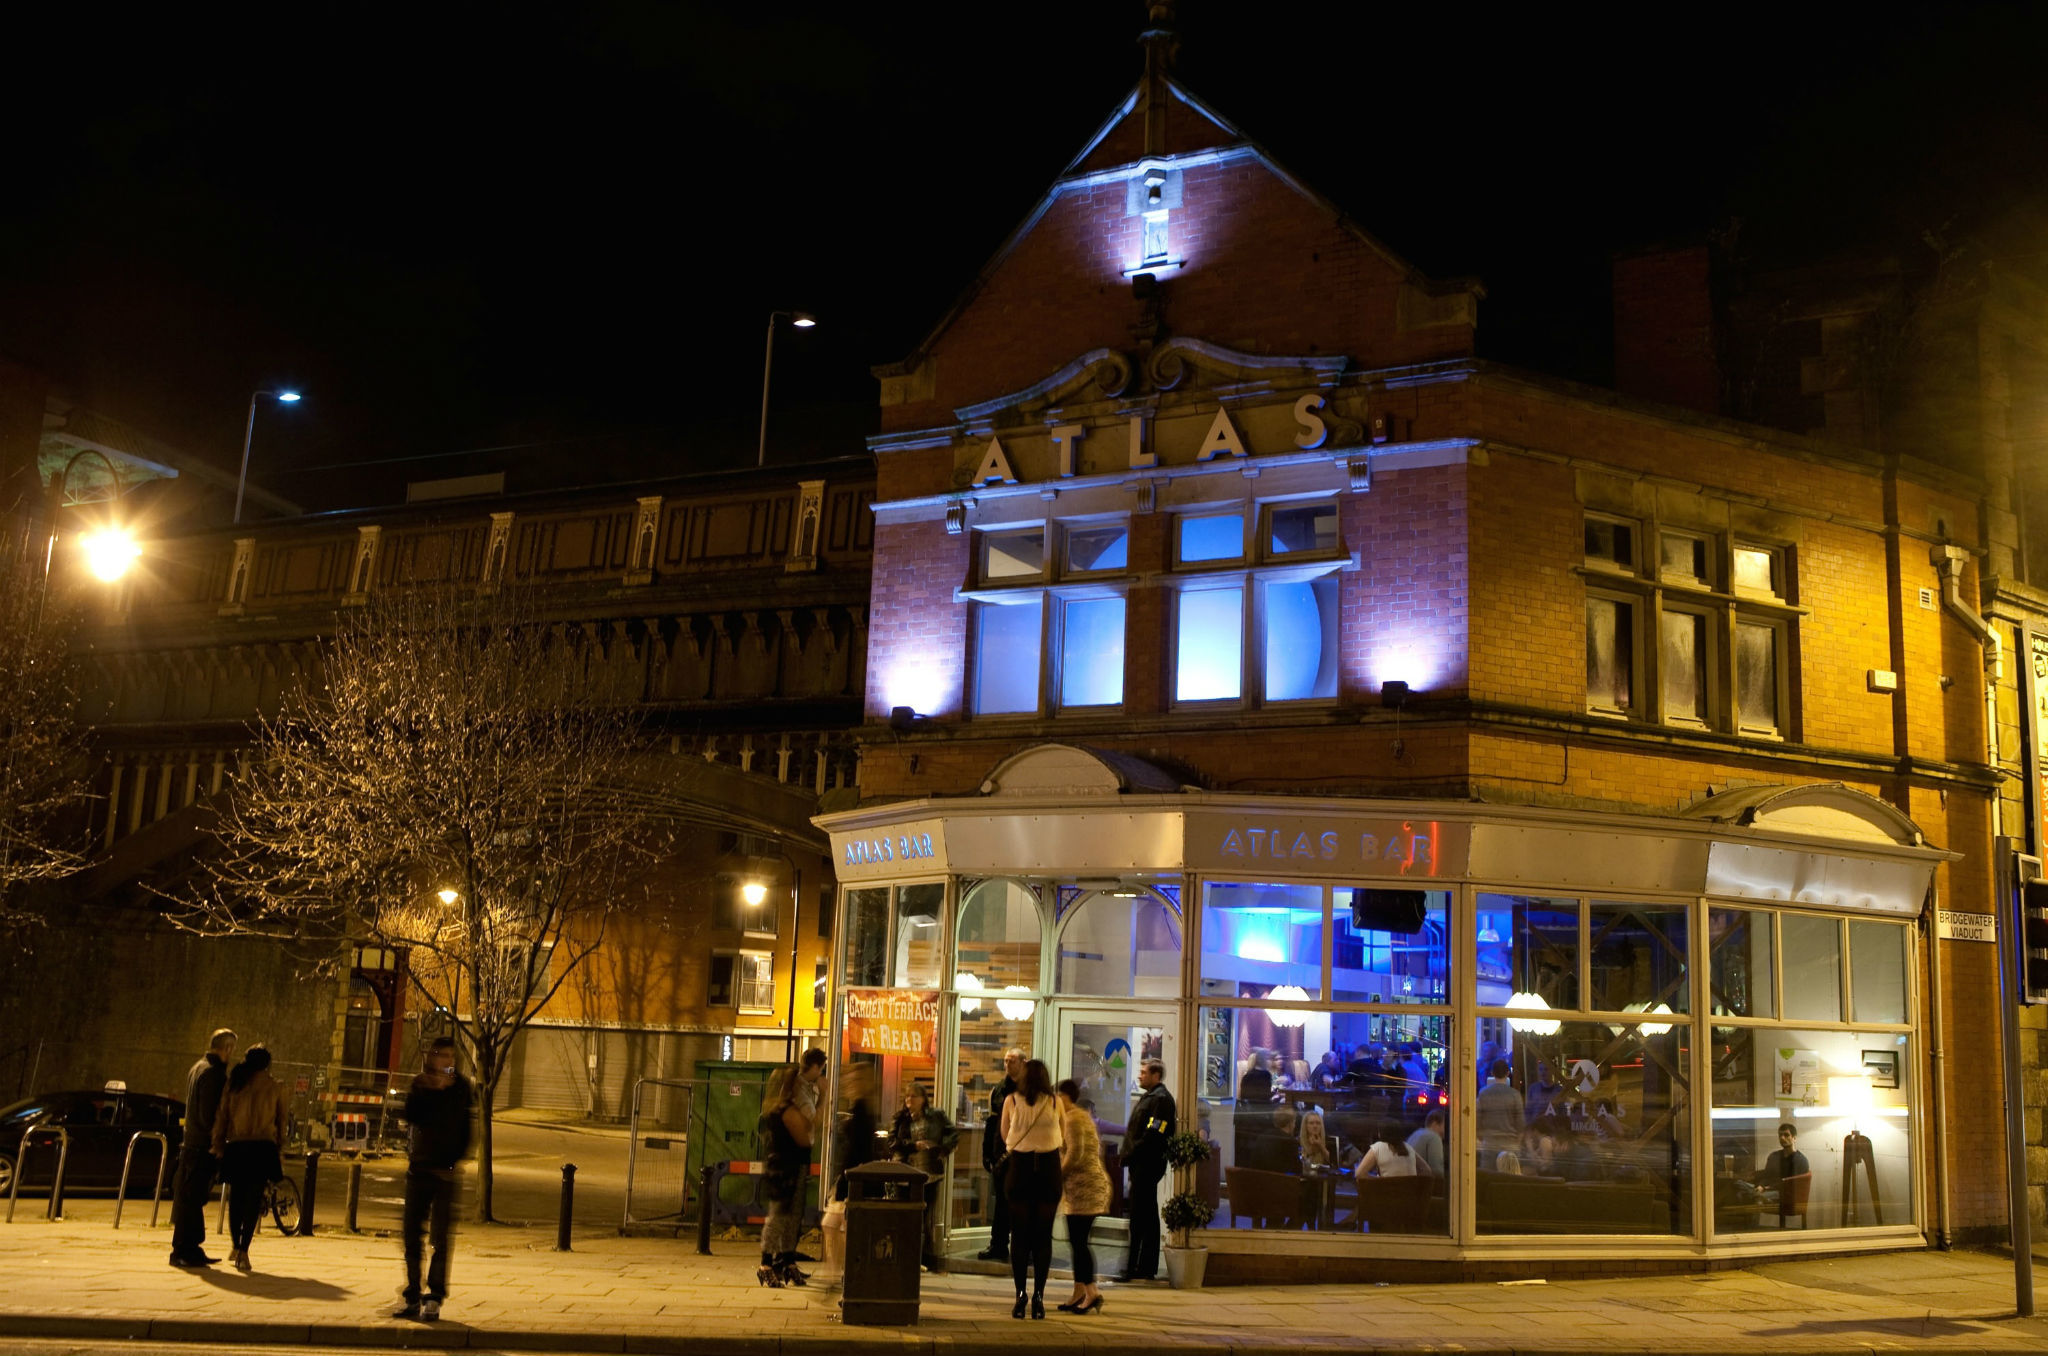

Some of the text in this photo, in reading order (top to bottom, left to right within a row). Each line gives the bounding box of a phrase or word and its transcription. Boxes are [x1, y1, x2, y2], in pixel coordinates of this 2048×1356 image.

[971, 393, 1328, 488] ATLAS
[845, 833, 935, 866] ATLAS BAR
[1220, 828, 1432, 863] ATLAS BAR
[1939, 912, 1993, 927] BRIDGEWATER
[1950, 926, 1984, 939] VIADUCT
[849, 993, 937, 1022] GARDEN TERRACE
[861, 1024, 922, 1052] AT REAR
[1080, 1077, 1139, 1092] ATLA
[1544, 1101, 1626, 1118] ATLAS
